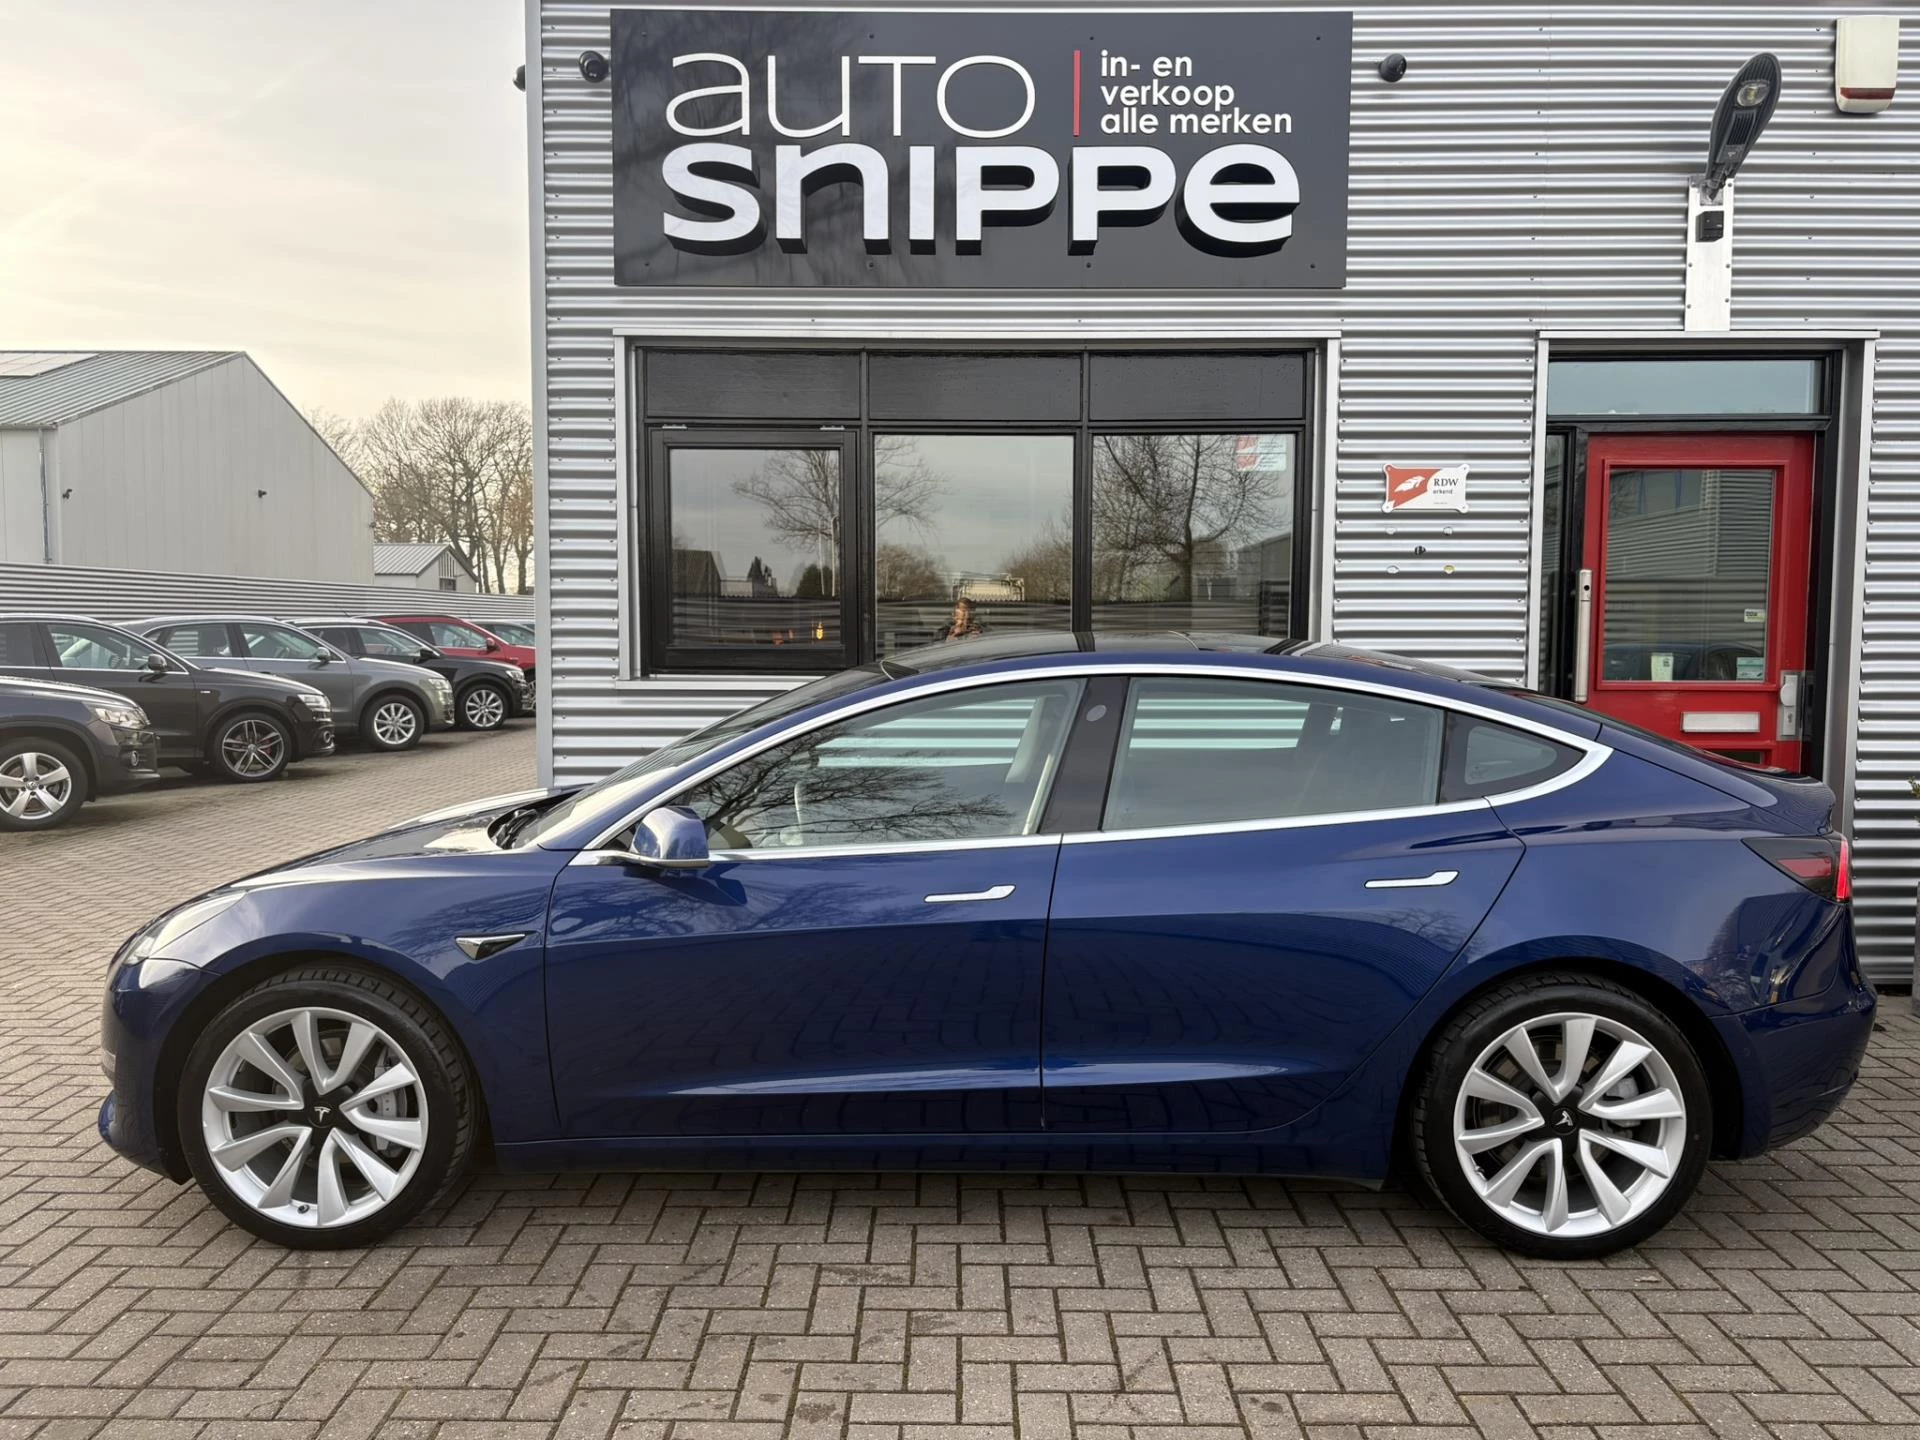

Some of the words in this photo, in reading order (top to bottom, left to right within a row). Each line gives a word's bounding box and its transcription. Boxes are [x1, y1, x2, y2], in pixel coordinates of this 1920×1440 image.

[1101, 50, 1141, 77] in-
[1152, 56, 1193, 77] en
[1101, 79, 1235, 112] verkoop
[1101, 107, 1159, 134] alle
[1169, 107, 1293, 134] merken
[1433, 478, 1459, 486] RDW
